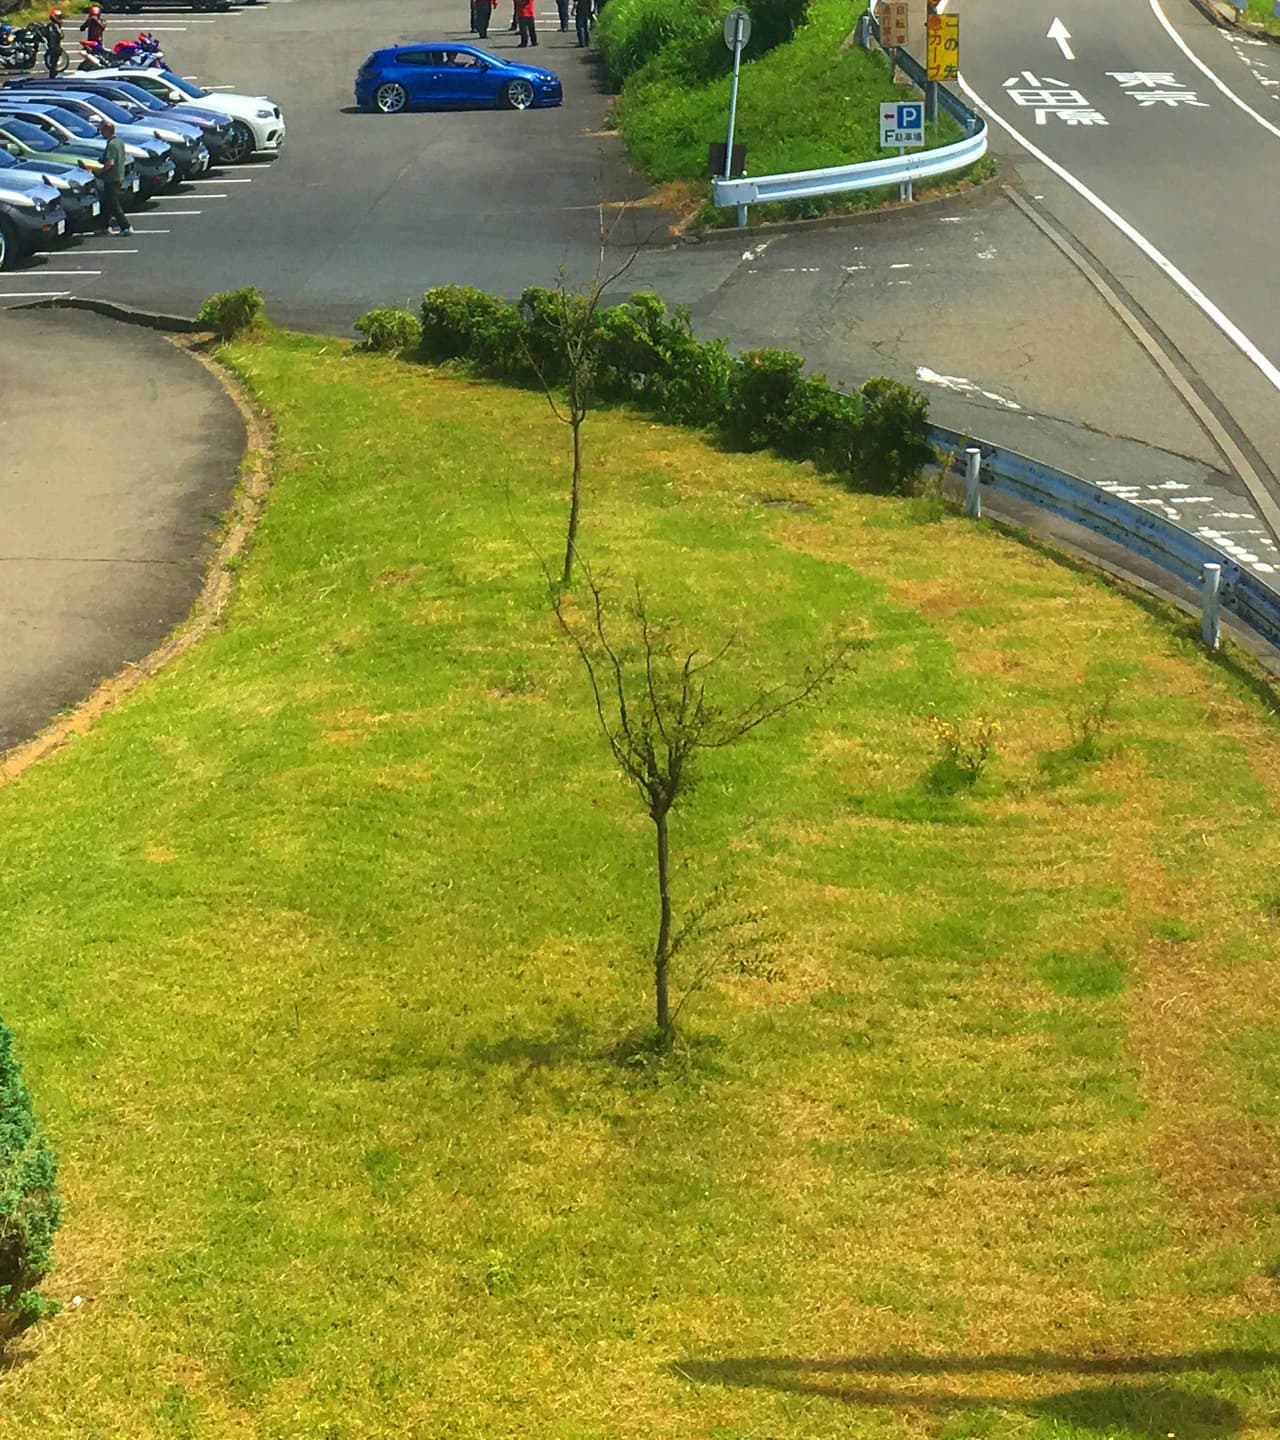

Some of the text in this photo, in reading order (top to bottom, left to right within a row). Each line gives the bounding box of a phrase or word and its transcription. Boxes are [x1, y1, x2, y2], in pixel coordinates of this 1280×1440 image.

[928, 15, 942, 79] 急カーブ
[943, 14, 958, 79] この先
[1002, 71, 1110, 125] 小田原
[1104, 71, 1210, 107] 東京
[903, 107, 917, 127] P
